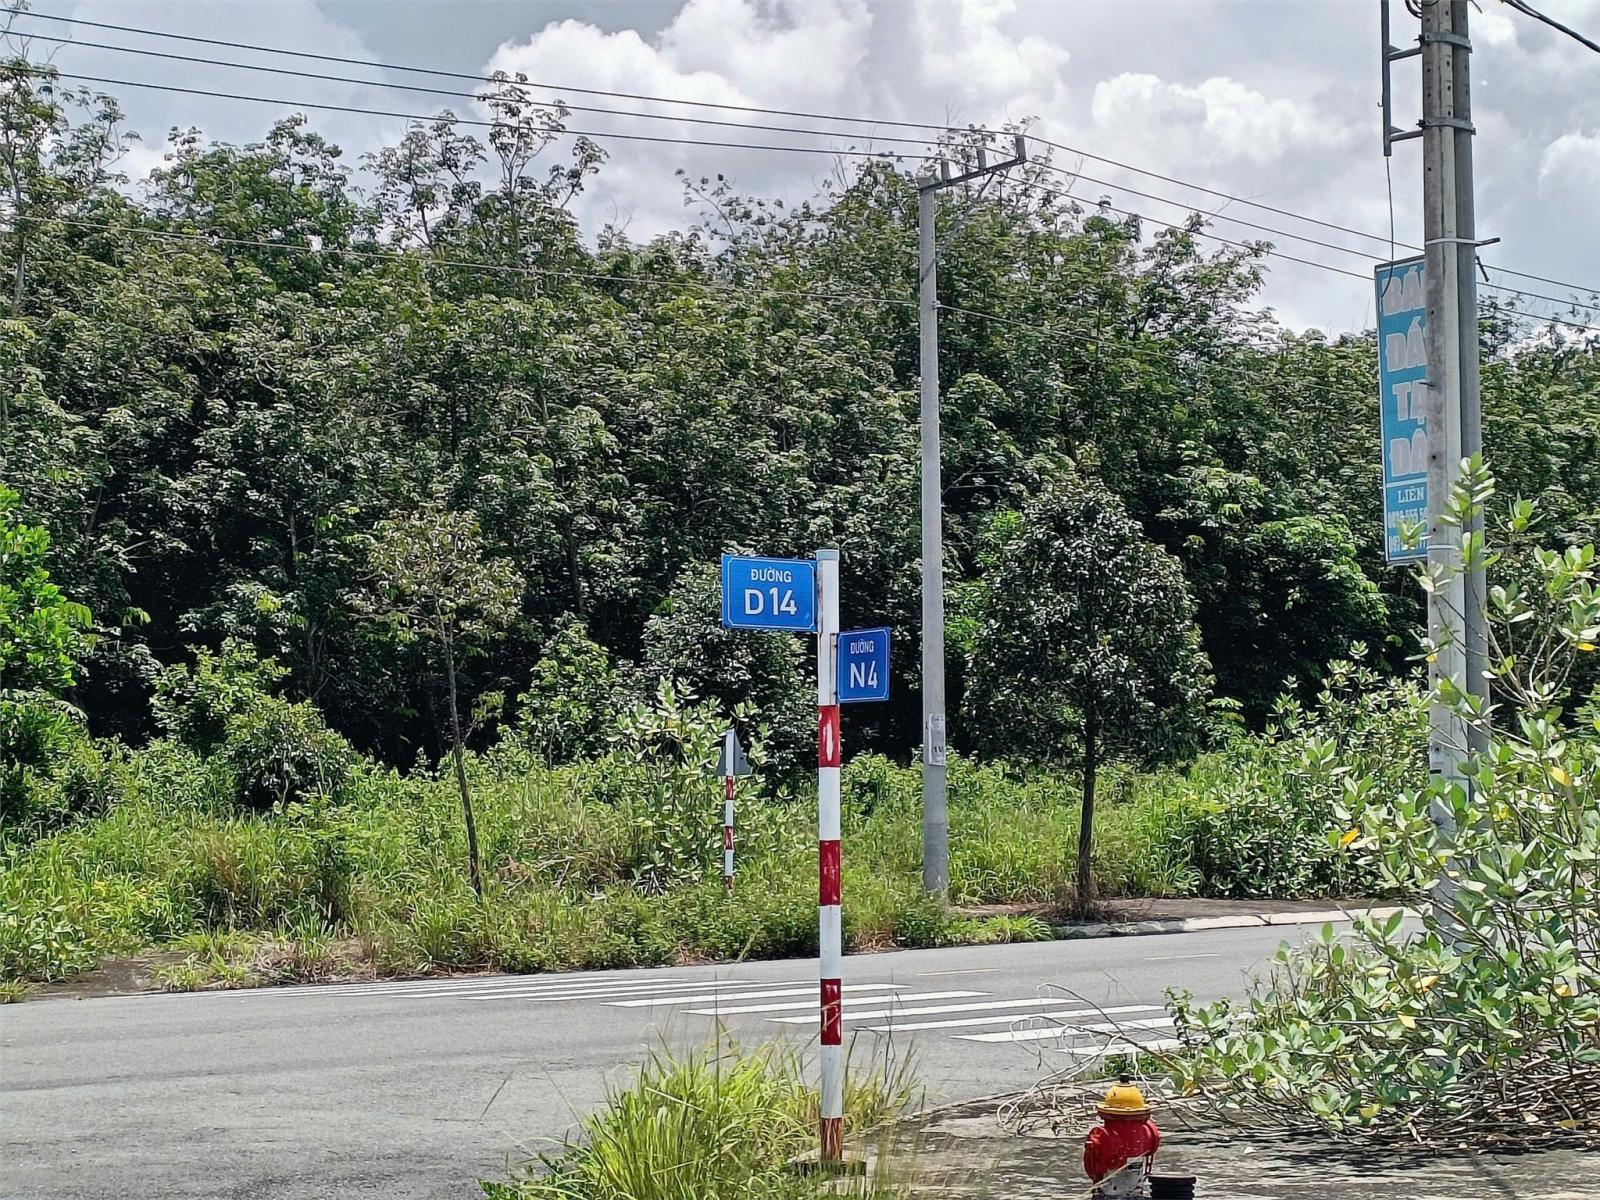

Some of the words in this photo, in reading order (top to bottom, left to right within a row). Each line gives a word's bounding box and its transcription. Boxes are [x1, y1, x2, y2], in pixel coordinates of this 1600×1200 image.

[1397, 485, 1425, 504] LIÊN
[751, 567, 792, 583] ĐƯỜNG
[850, 660, 878, 689] N4
